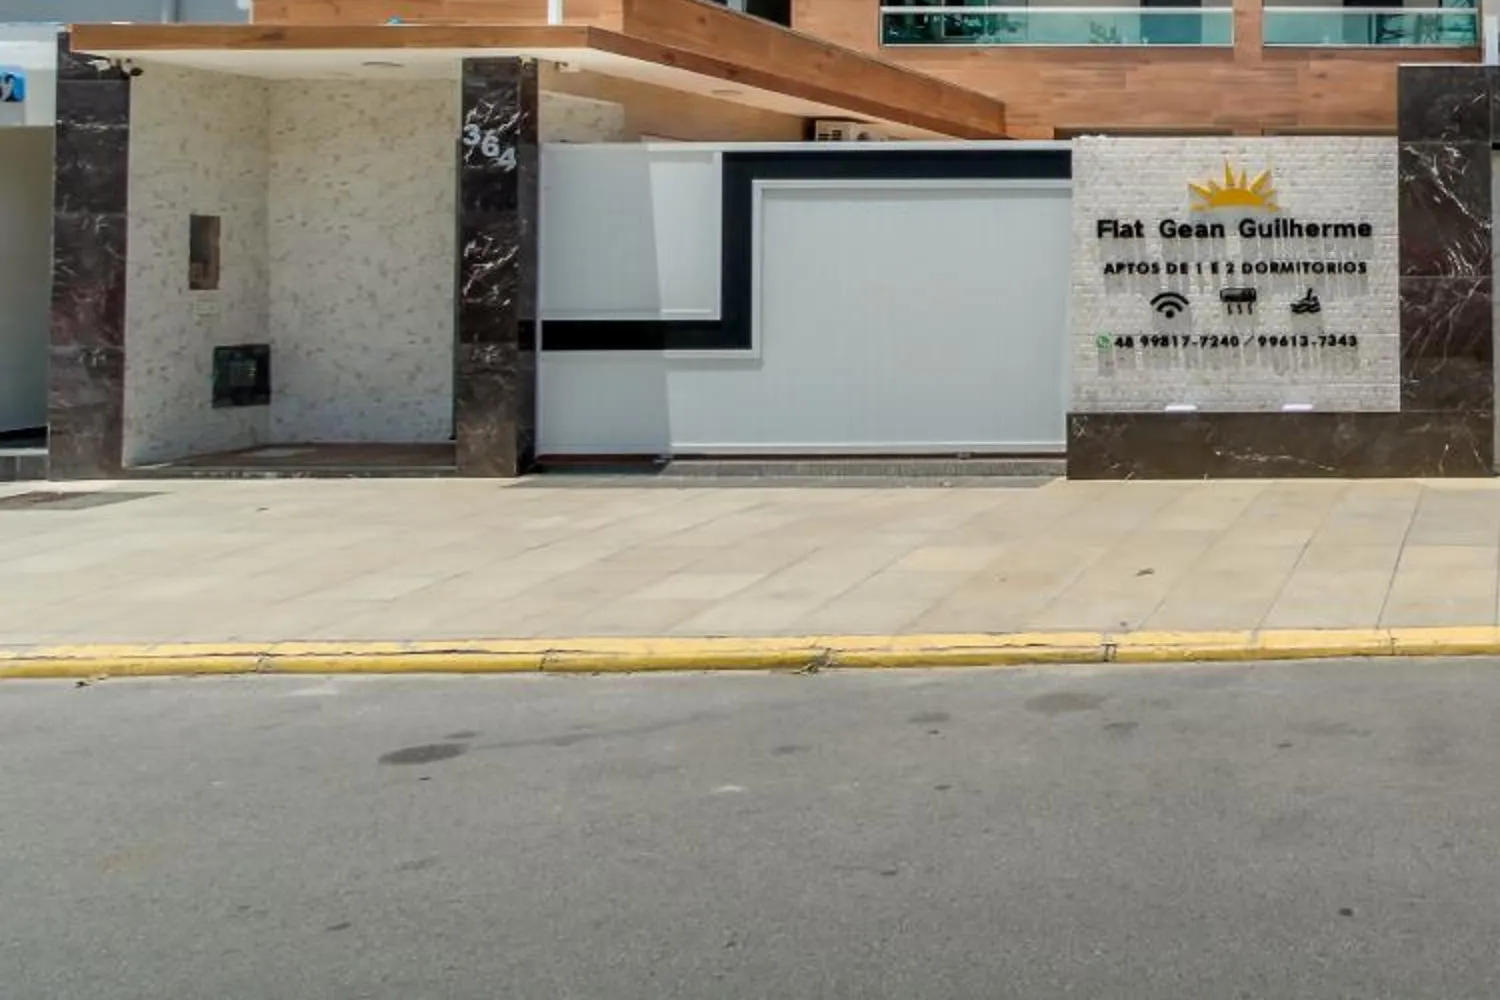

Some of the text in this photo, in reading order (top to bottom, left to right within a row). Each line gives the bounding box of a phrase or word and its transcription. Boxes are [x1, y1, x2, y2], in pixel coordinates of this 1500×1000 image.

[463, 123, 518, 173] 364
[1097, 217, 1373, 239] Flat Gean Guilherme
[1103, 261, 1160, 275] APTOS
[1165, 262, 1188, 275] DE
[1195, 262, 1202, 275] 1
[1225, 261, 1235, 275] 2
[1114, 335, 1134, 348] 48
